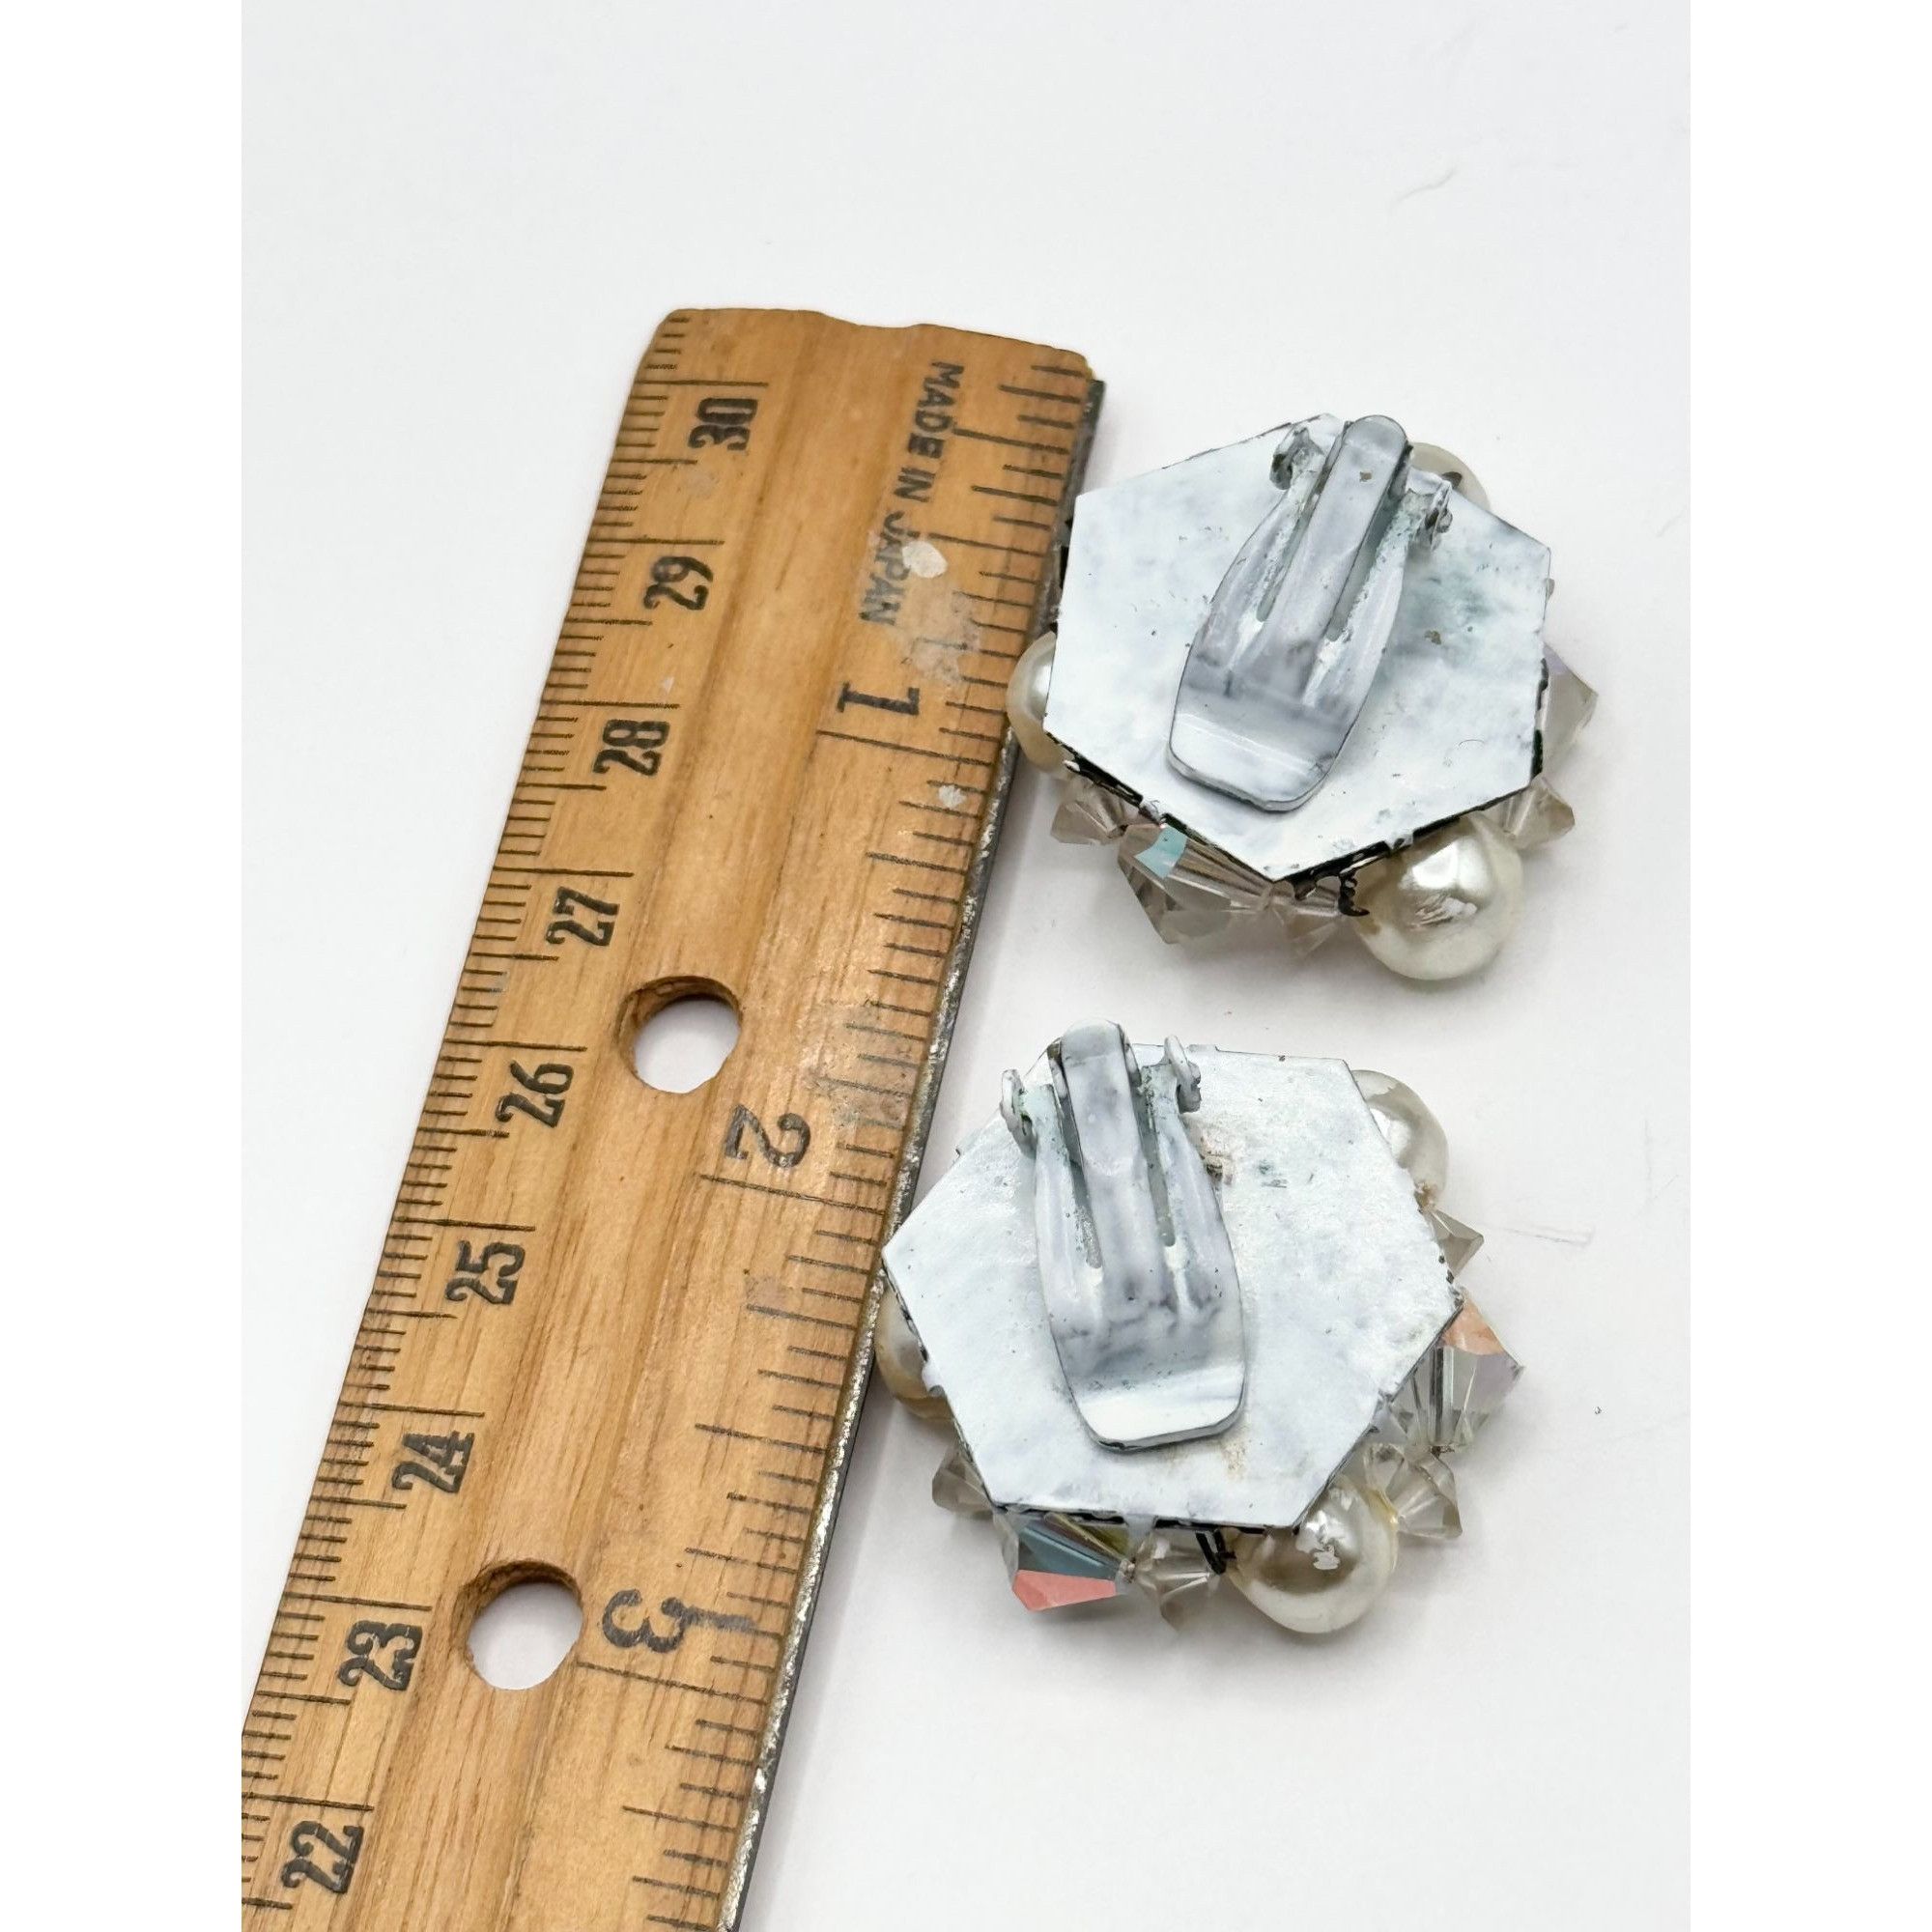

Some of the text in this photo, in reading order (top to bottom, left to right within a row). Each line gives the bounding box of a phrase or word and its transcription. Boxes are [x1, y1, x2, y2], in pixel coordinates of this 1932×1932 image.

[688, 397, 758, 451] 30
[859, 361, 964, 626] MADE IN JAPAN
[643, 555, 714, 611] 29
[837, 682, 921, 717] 1
[593, 719, 669, 777] 28
[546, 887, 620, 947] 27
[495, 1060, 574, 1128] 26
[724, 1104, 811, 1168] 2
[445, 1239, 526, 1306] 25
[391, 1431, 475, 1494] 24
[338, 1620, 423, 1691] 23
[281, 1820, 364, 1894] 22
